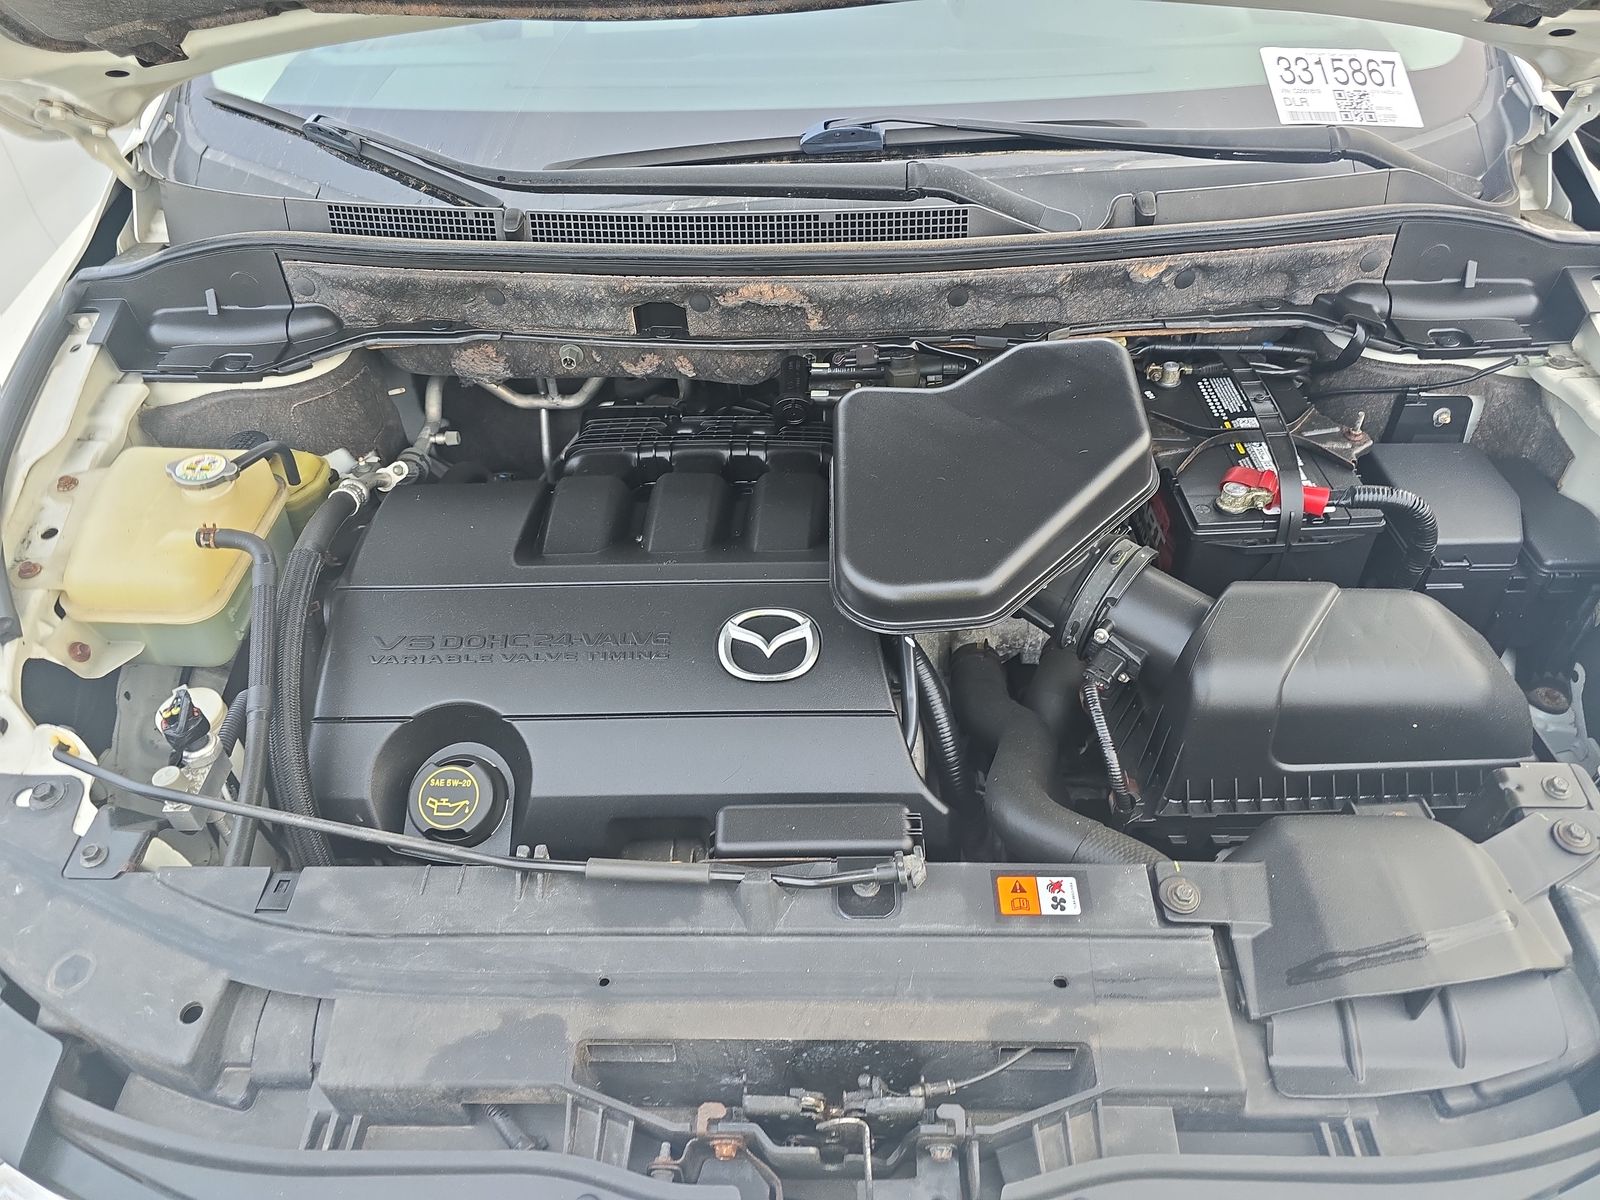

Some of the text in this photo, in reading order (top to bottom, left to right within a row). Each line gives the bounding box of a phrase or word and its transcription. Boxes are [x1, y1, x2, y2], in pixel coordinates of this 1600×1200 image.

[1276, 55, 1396, 87] 3315867
[1282, 97, 1310, 107] DLR
[373, 631, 672, 651] V6 DOHC 24-VALVE
[368, 650, 671, 665] VARIABLE VALVE TIMING
[430, 778, 445, 787] SAE
